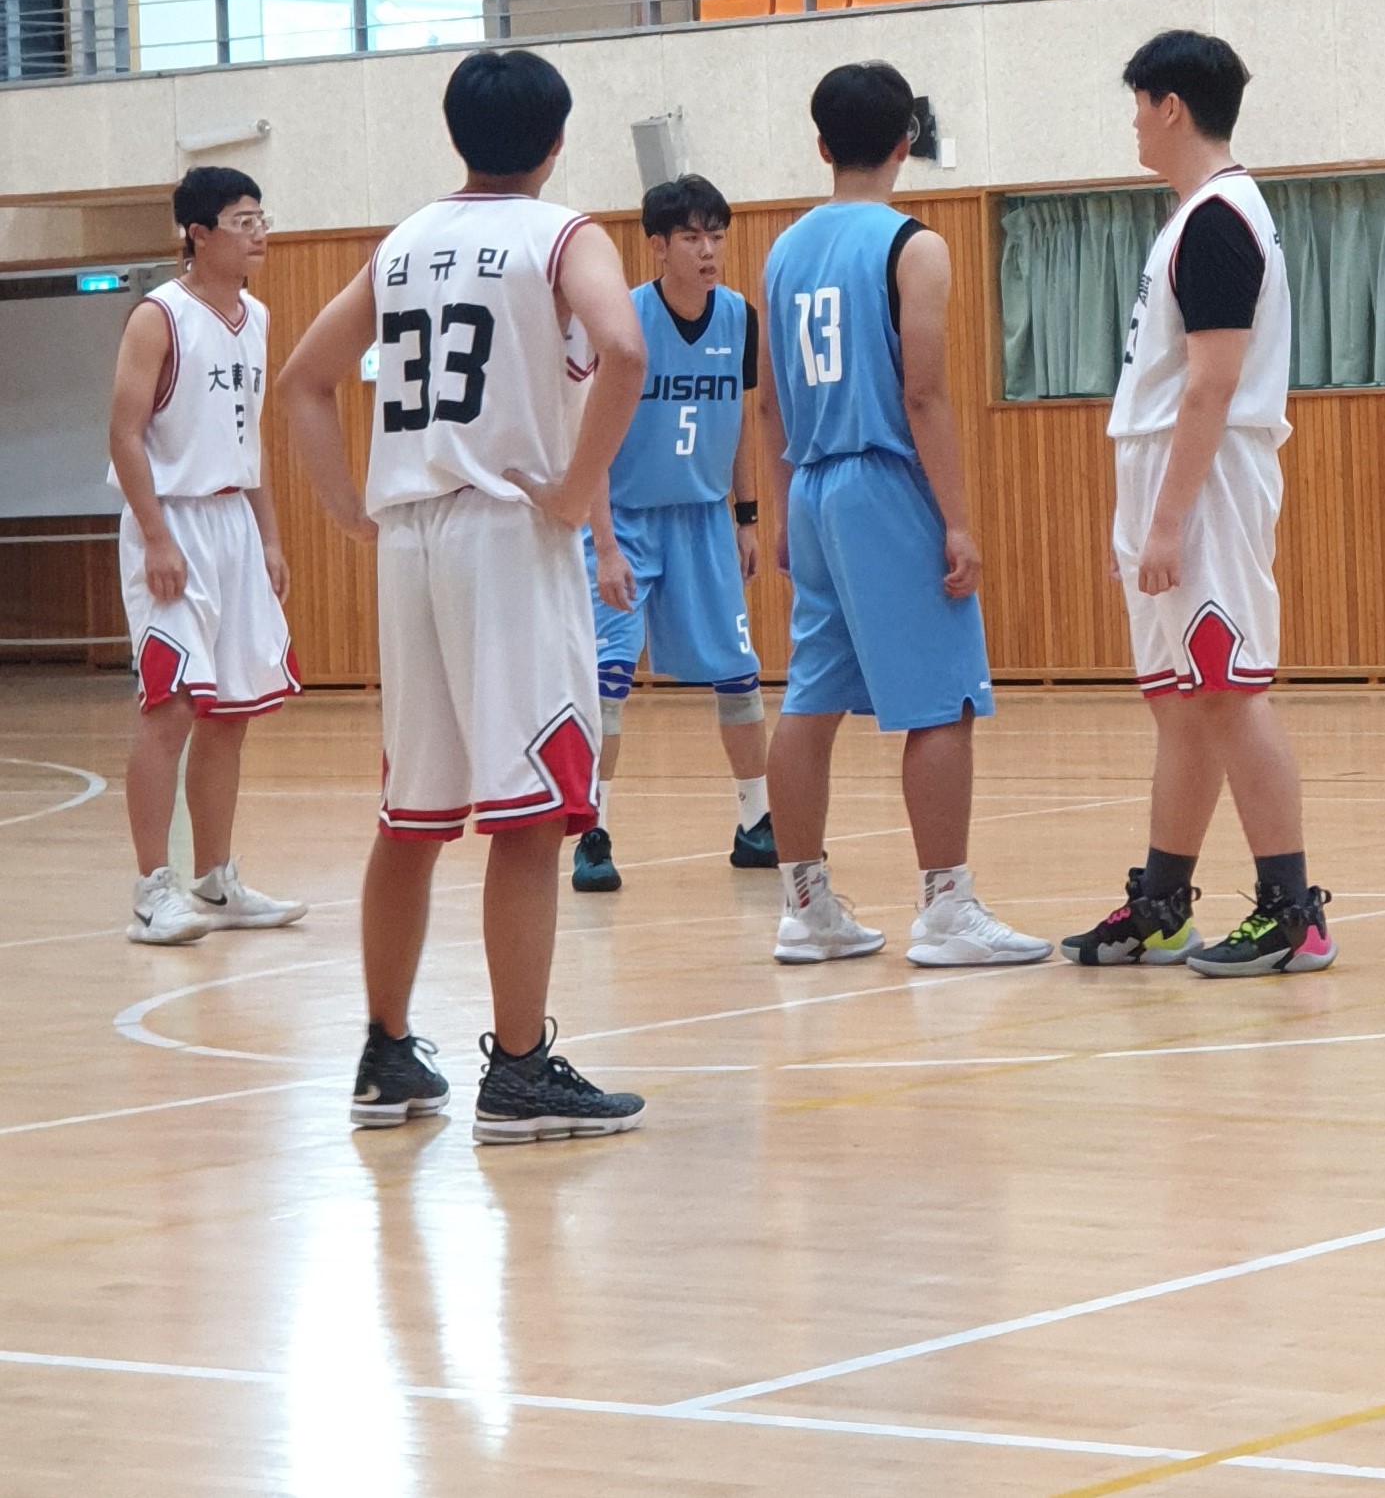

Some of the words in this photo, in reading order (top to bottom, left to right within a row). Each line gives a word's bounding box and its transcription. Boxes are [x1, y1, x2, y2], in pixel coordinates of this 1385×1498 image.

[382, 302, 495, 433] 33
[794, 286, 842, 387] 13
[675, 405, 697, 455] 5
[736, 613, 751, 654] 5
